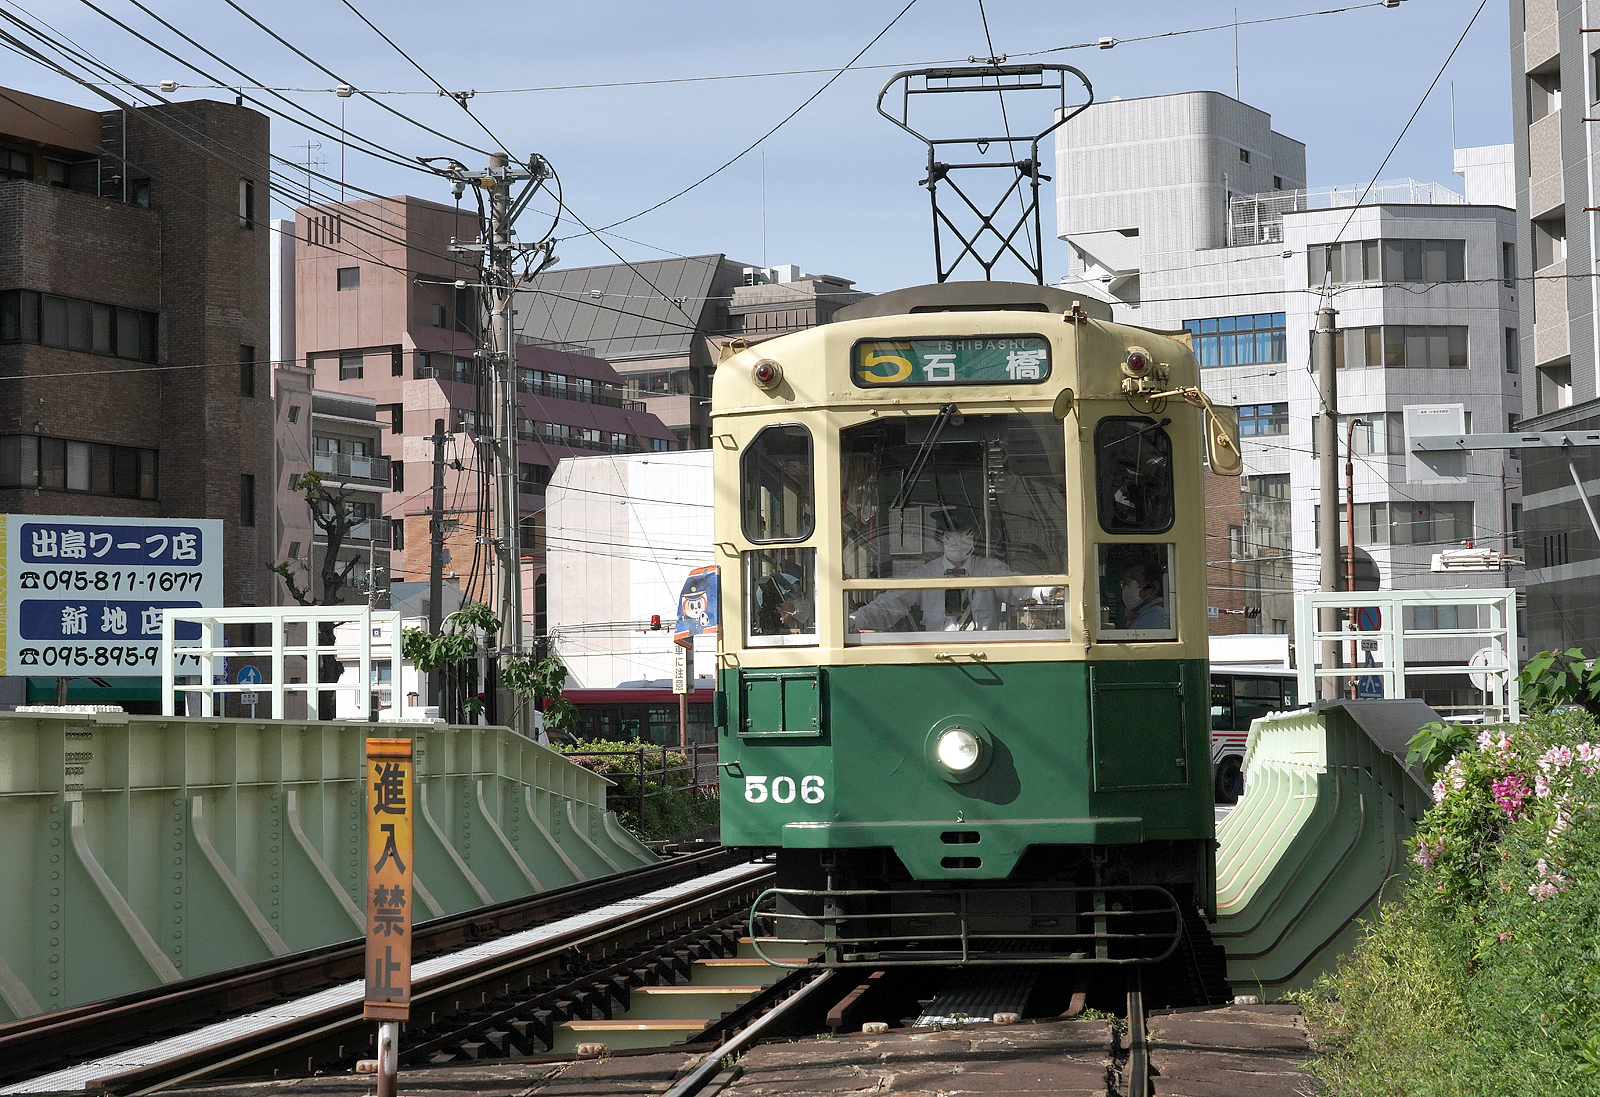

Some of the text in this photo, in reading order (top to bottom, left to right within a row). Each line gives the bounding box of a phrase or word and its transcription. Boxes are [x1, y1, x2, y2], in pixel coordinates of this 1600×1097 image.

[938, 340, 1025, 351] ISHIBASHI
[857, 343, 913, 383] 5
[31, 529, 198, 561] 出島ワーフ店
[42, 570, 203, 592] 095-811-1677
[61, 605, 163, 635] 新地店
[42, 646, 203, 667] 095-895-979
[744, 775, 825, 804] 506
[371, 761, 407, 998] 進入禁止
